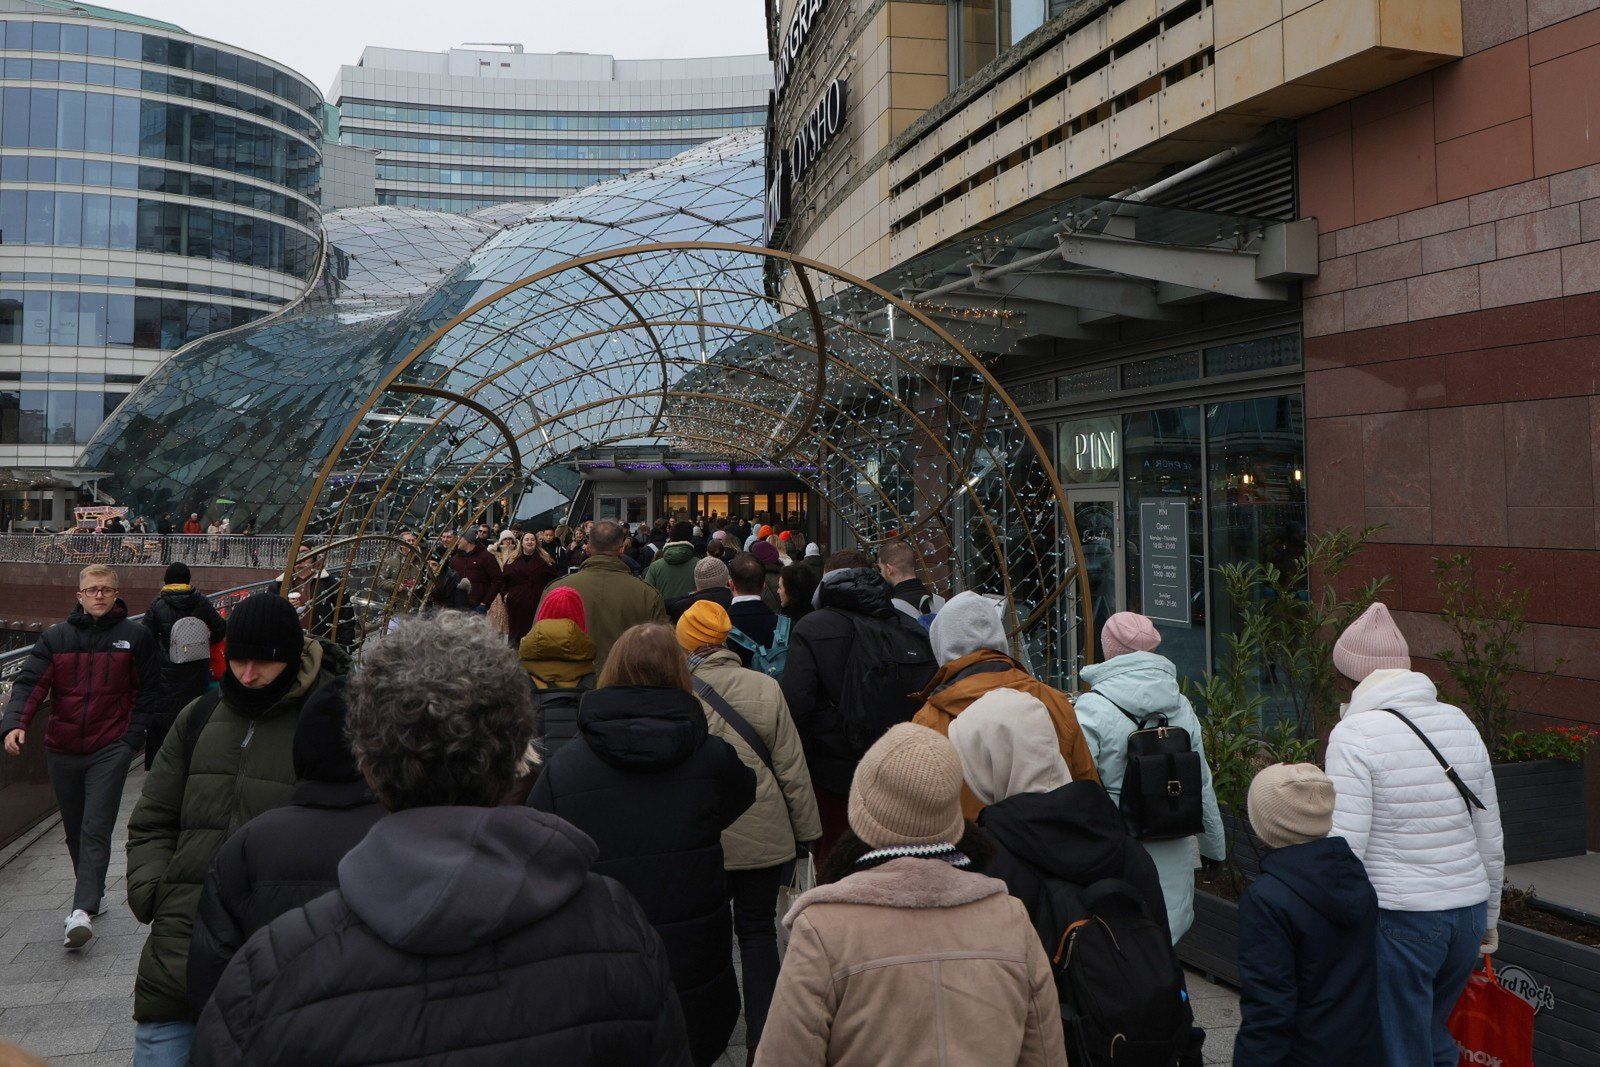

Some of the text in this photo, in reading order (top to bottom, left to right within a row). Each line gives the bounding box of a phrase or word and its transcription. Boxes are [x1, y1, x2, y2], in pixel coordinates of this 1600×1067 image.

[791, 78, 841, 182] OYSHO
[1075, 430, 1116, 470] PIN
[1519, 979, 1553, 1008] Rock
